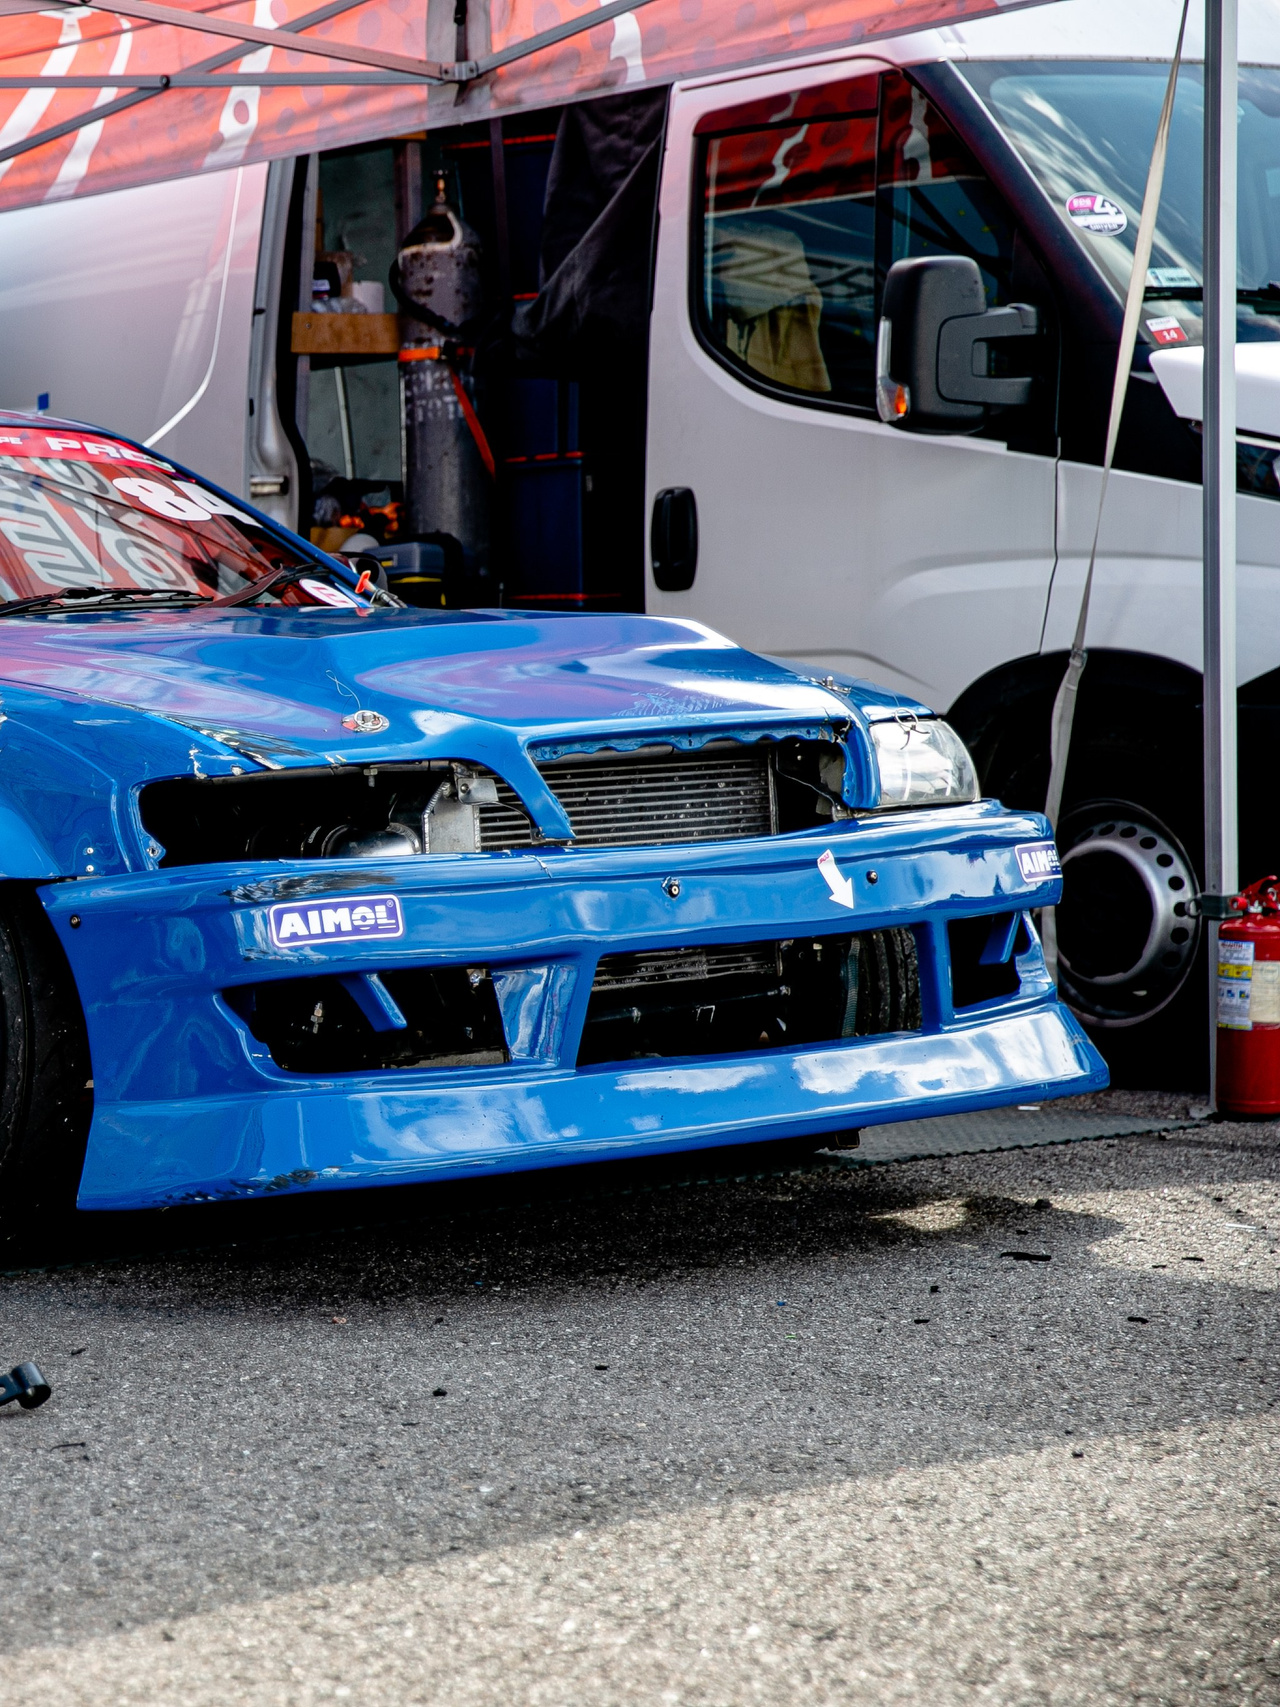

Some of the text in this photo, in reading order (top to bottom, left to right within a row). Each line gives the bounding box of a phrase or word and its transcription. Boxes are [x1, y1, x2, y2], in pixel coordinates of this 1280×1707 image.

[1094, 195, 1120, 216] 4
[112, 477, 264, 528] 84
[279, 904, 397, 939] AIMOL
